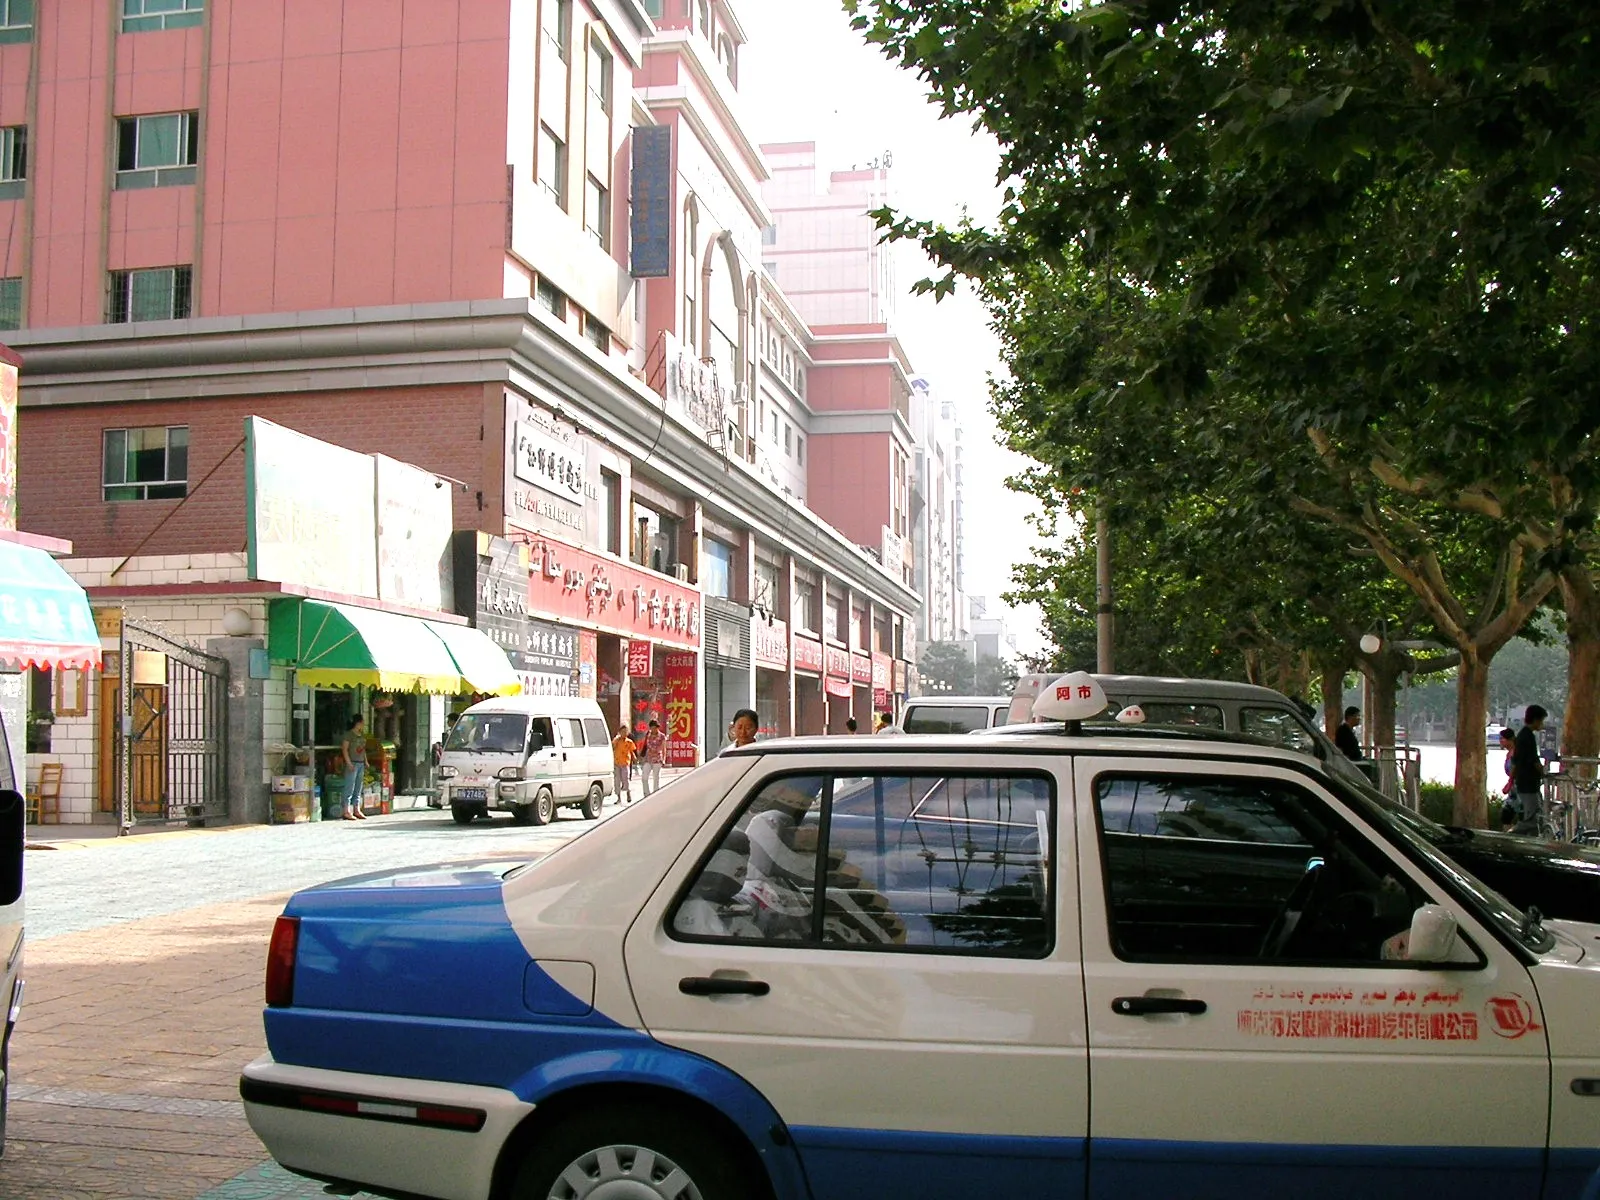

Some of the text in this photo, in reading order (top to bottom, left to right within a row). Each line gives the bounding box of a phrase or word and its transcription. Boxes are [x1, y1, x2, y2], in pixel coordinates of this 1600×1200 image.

[632, 585, 699, 637] 仁合大药房
[630, 654, 648, 674] 药
[1056, 685, 1091, 701] 阿市
[666, 698, 693, 739] 药
[1237, 1010, 1478, 1040] 阿克苏发展旅游出租汽车有限公司
